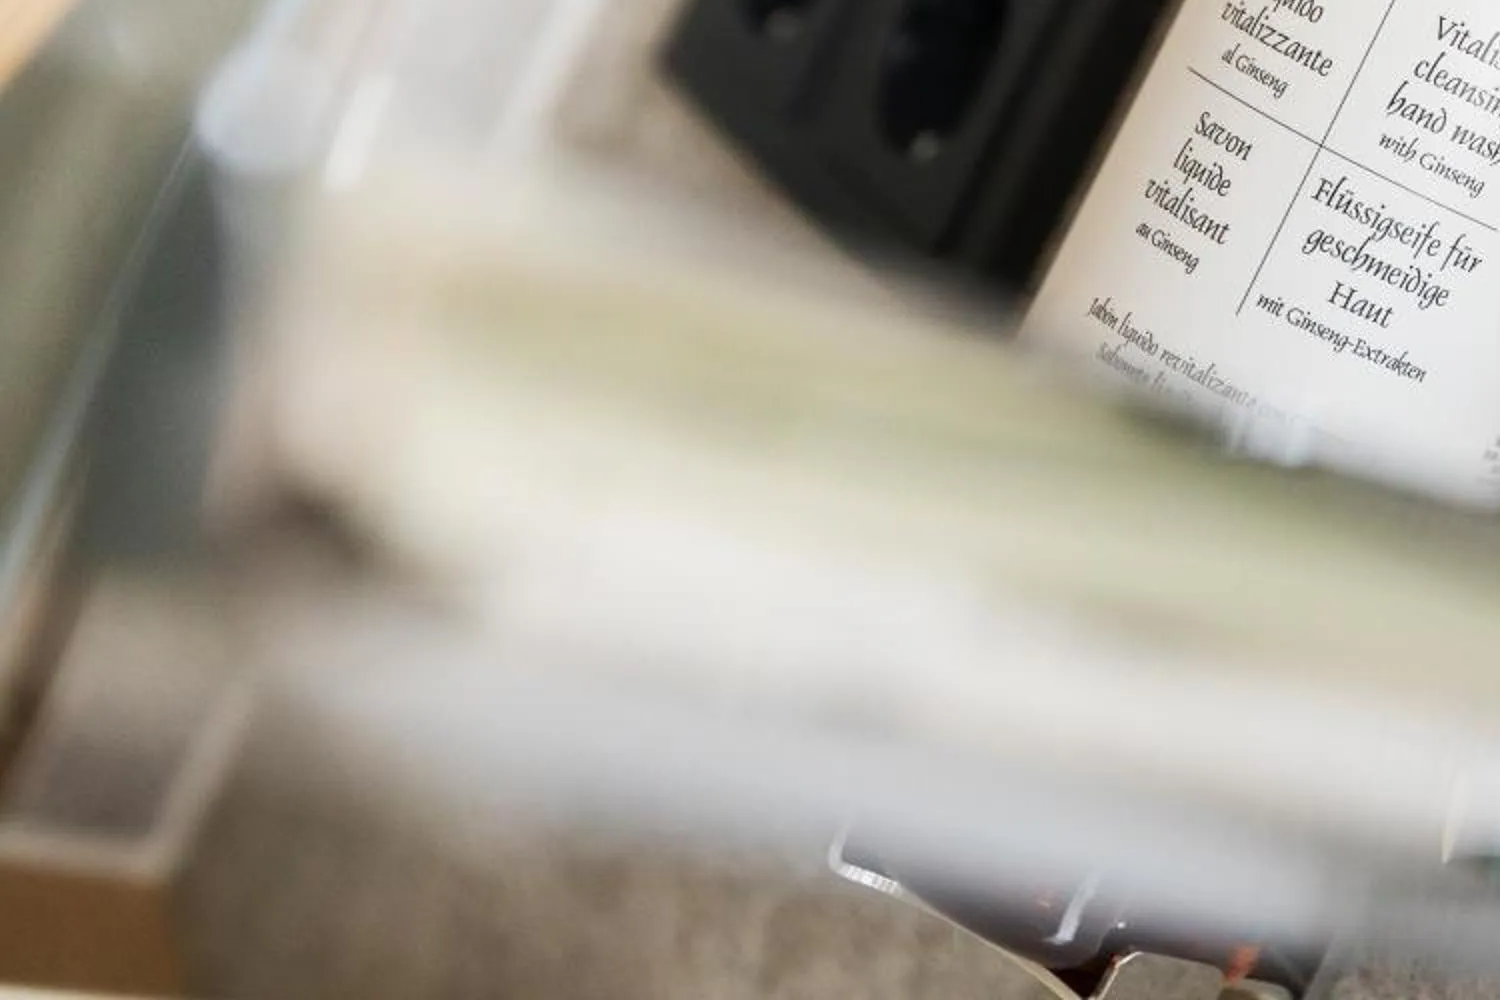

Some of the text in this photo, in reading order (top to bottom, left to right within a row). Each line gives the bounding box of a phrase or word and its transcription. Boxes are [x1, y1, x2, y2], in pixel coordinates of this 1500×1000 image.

[1220, 0, 1333, 77] vitalizzante
[1221, 43, 1290, 99] al Ginseng
[1194, 111, 1253, 161] Savon
[1386, 79, 1448, 135] hand
[1173, 136, 1232, 197] liquide
[1379, 132, 1486, 199] with Ginseng
[1144, 178, 1230, 245] vitalisant
[1311, 175, 1484, 274] Flüssigseife für
[1135, 222, 1201, 275] au Ginseng
[1301, 228, 1450, 311] geschmeidige
[1327, 279, 1395, 329] Haut
[1256, 293, 1428, 384] mit Ginseng-Extrakten
